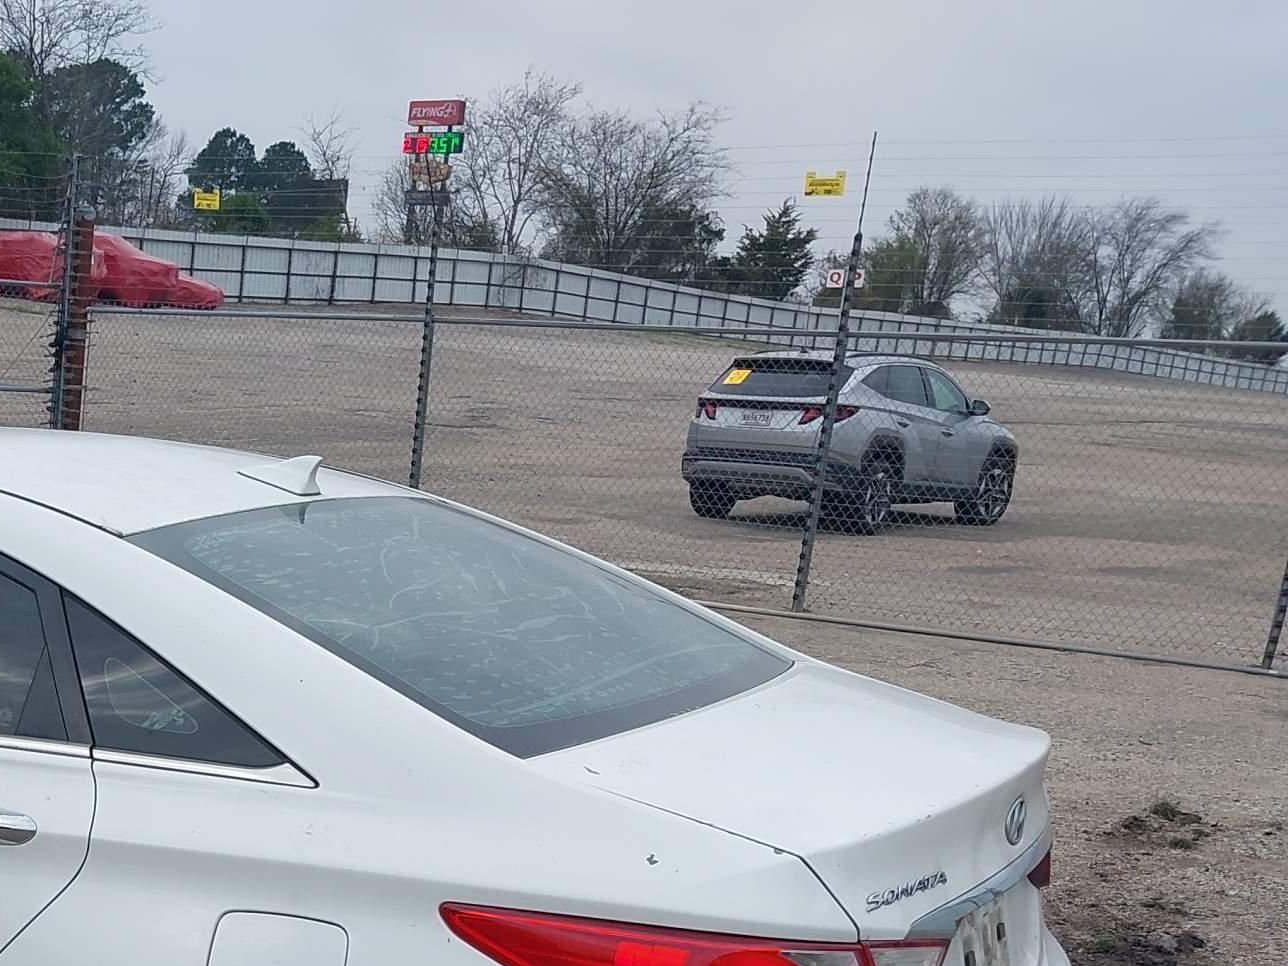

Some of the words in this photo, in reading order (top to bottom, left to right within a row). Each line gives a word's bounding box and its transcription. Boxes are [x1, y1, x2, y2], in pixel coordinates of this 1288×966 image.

[411, 106, 444, 118] FLYING
[829, 271, 842, 286] Q
[866, 871, 947, 913] SONATA
